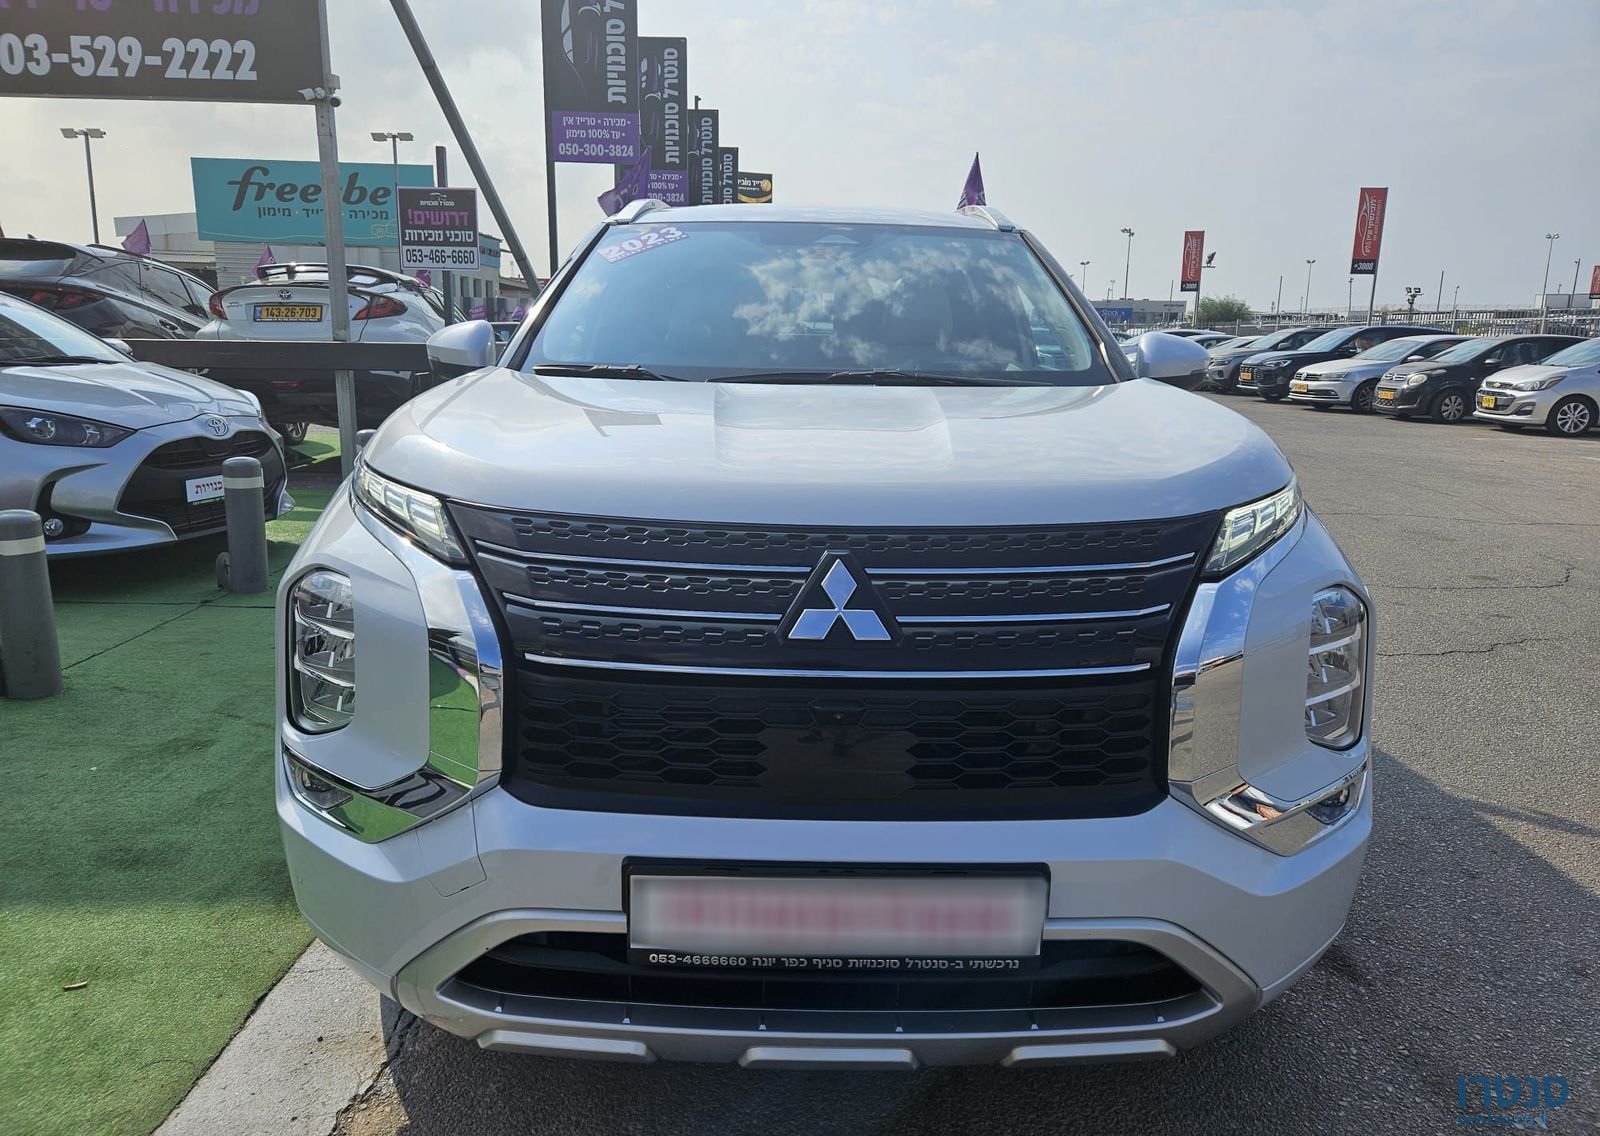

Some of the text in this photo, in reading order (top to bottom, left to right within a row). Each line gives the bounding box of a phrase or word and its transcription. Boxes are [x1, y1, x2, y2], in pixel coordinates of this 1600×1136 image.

[0, 32, 258, 81] 03-529-2222
[606, 18, 627, 104] סוכנויות
[663, 47, 680, 164] סנטרל סוכנויות
[562, 116, 574, 126] אין
[603, 117, 627, 127] מכירה
[566, 129, 586, 139] מימון
[610, 130, 621, 139] עד
[701, 117, 713, 155] סנטרל
[558, 142, 634, 157] 050-300-3824
[723, 153, 733, 186] סנטרל
[227, 165, 392, 212] freebe
[648, 192, 685, 202] 300-3824
[257, 206, 292, 219] מימון
[350, 209, 389, 220] מכירה
[408, 208, 469, 226] דרושים!
[404, 229, 474, 242] סוכני מכירות
[597, 227, 683, 260] 2023
[405, 248, 475, 264] 053-466-6660
[195, 481, 223, 494] כנויות
[649, 953, 1021, 969] נרכשתי ב-סנטרל סוכנויות סניף כפר יונה 053-4666660
